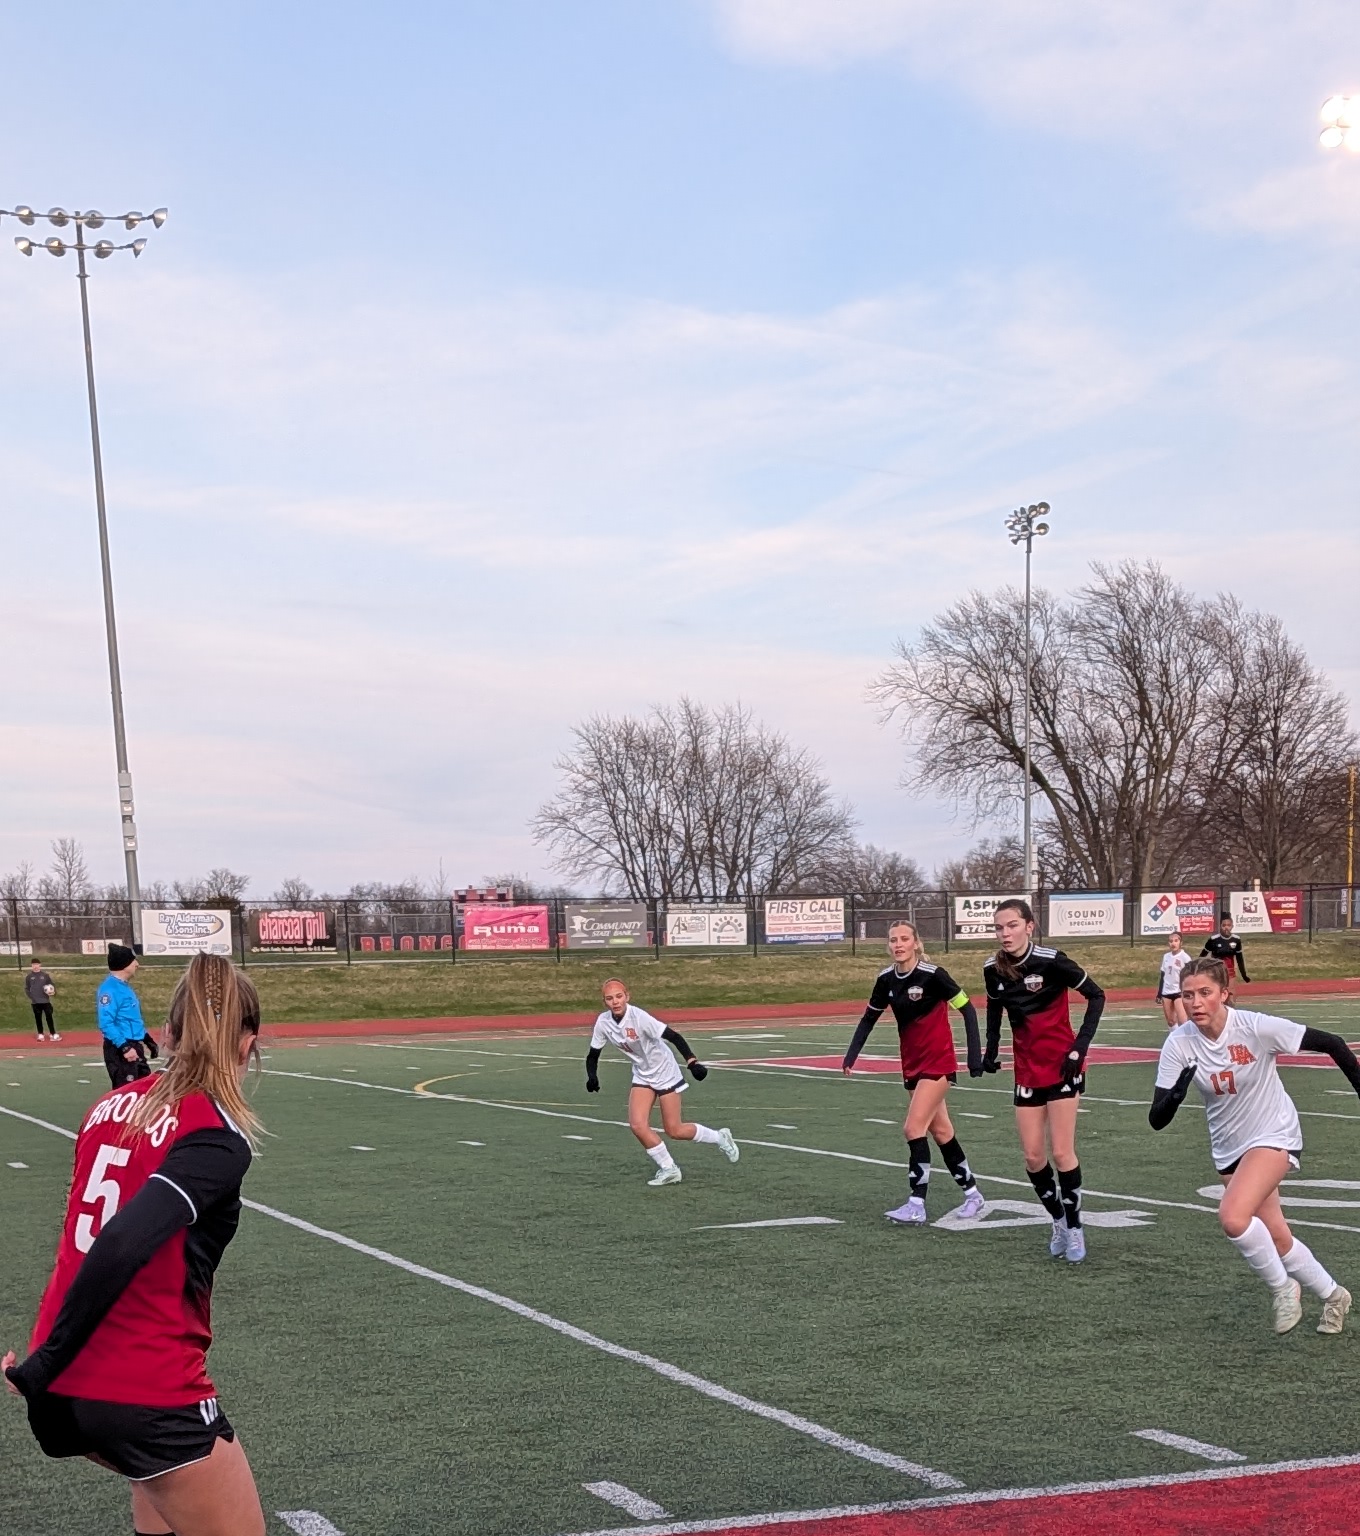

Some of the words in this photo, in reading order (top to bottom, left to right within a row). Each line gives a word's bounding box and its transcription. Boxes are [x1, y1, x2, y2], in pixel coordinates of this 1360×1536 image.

[769, 902, 806, 913] FIRST
[810, 901, 842, 913] CALL
[962, 899, 1001, 910] ASPH
[159, 913, 174, 925] Ray
[176, 913, 216, 923] Alderman
[768, 914, 794, 923] Heating
[795, 913, 800, 921] &
[1067, 910, 1105, 918] SOUND
[1236, 915, 1263, 923] Educators
[166, 925, 173, 935] &
[174, 925, 193, 934] Sons
[259, 911, 304, 940] charcoal
[583, 918, 643, 931] COMMUNITY
[1143, 924, 1178, 932] Domino's
[1209, 1071, 1237, 1095] 17
[83, 1091, 179, 1147] BRONOS
[74, 1144, 132, 1255] 5
